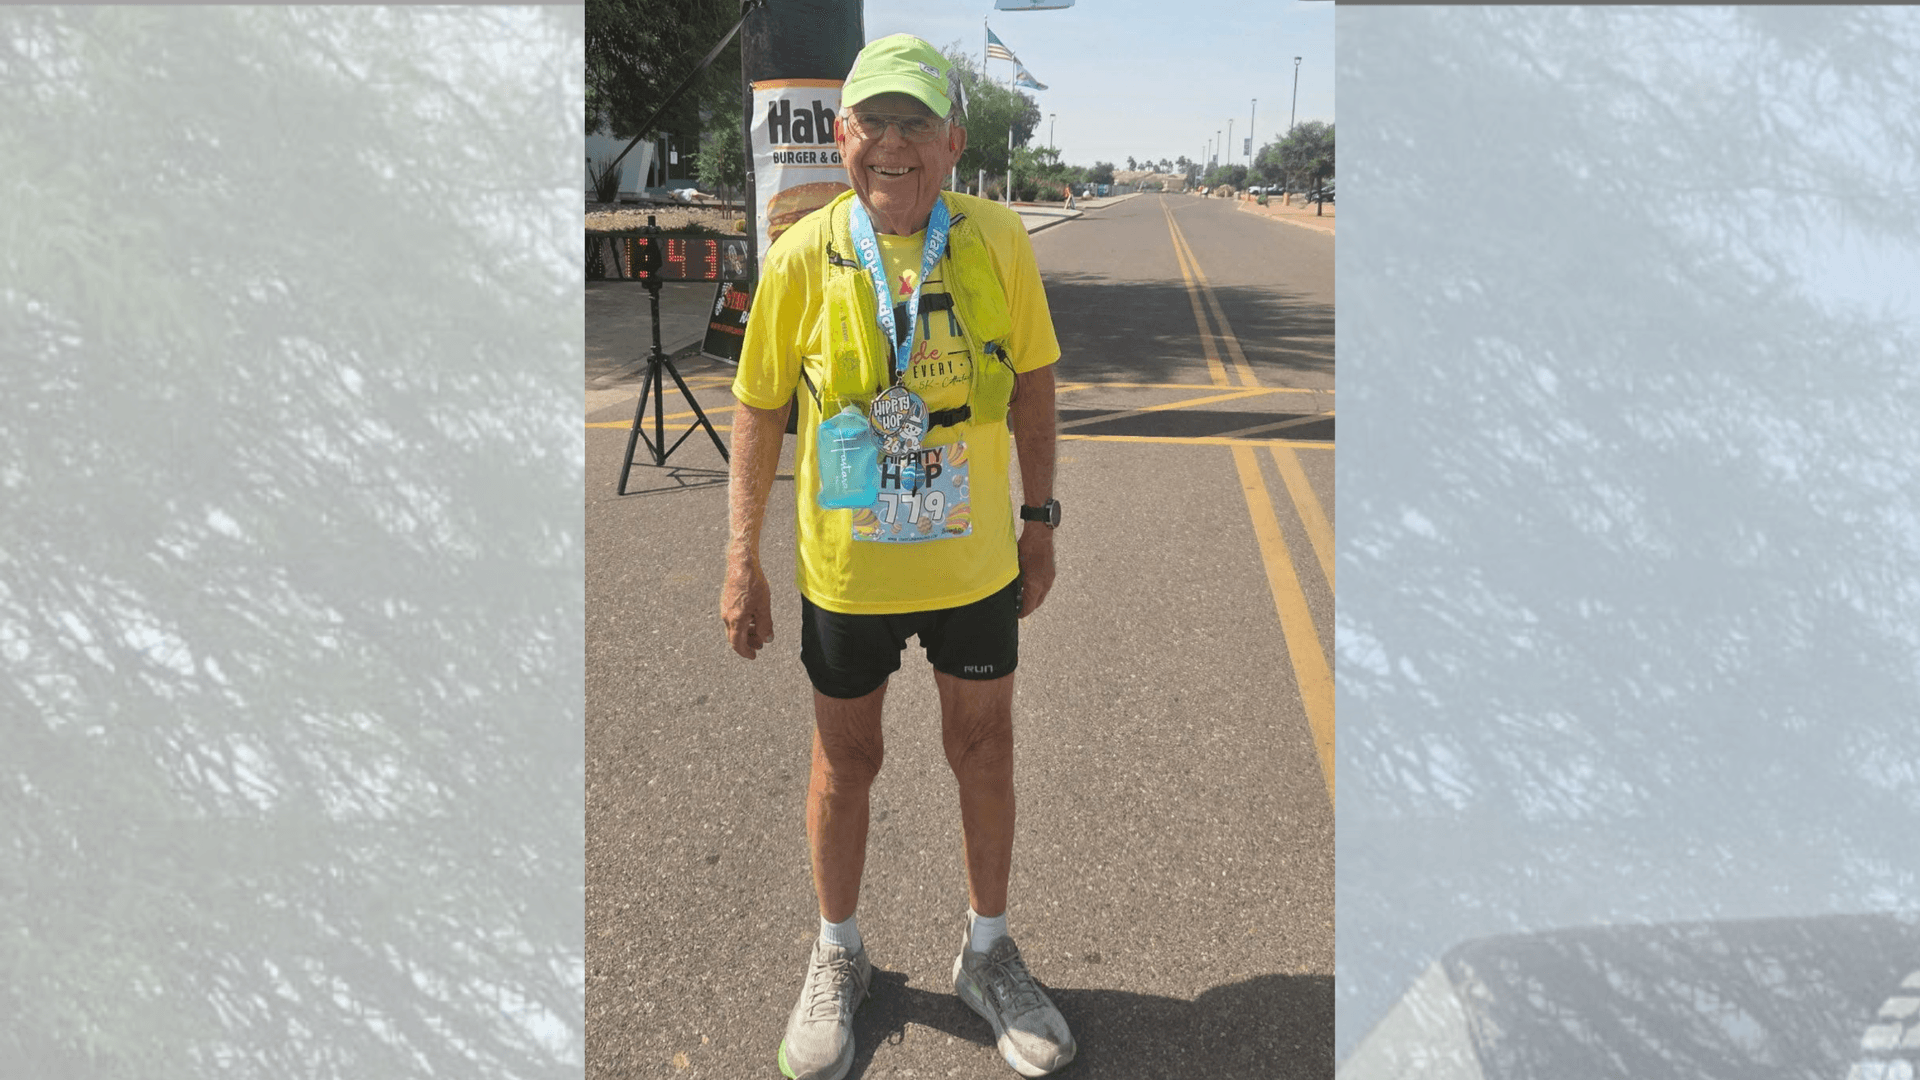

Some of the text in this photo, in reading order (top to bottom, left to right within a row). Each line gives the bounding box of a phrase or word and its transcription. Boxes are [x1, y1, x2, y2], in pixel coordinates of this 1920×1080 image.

[773, 151, 817, 164] BURGER
[820, 151, 828, 164] &
[913, 360, 953, 379] EVERY
[882, 413, 903, 429] HOP
[878, 491, 946, 524] 779
